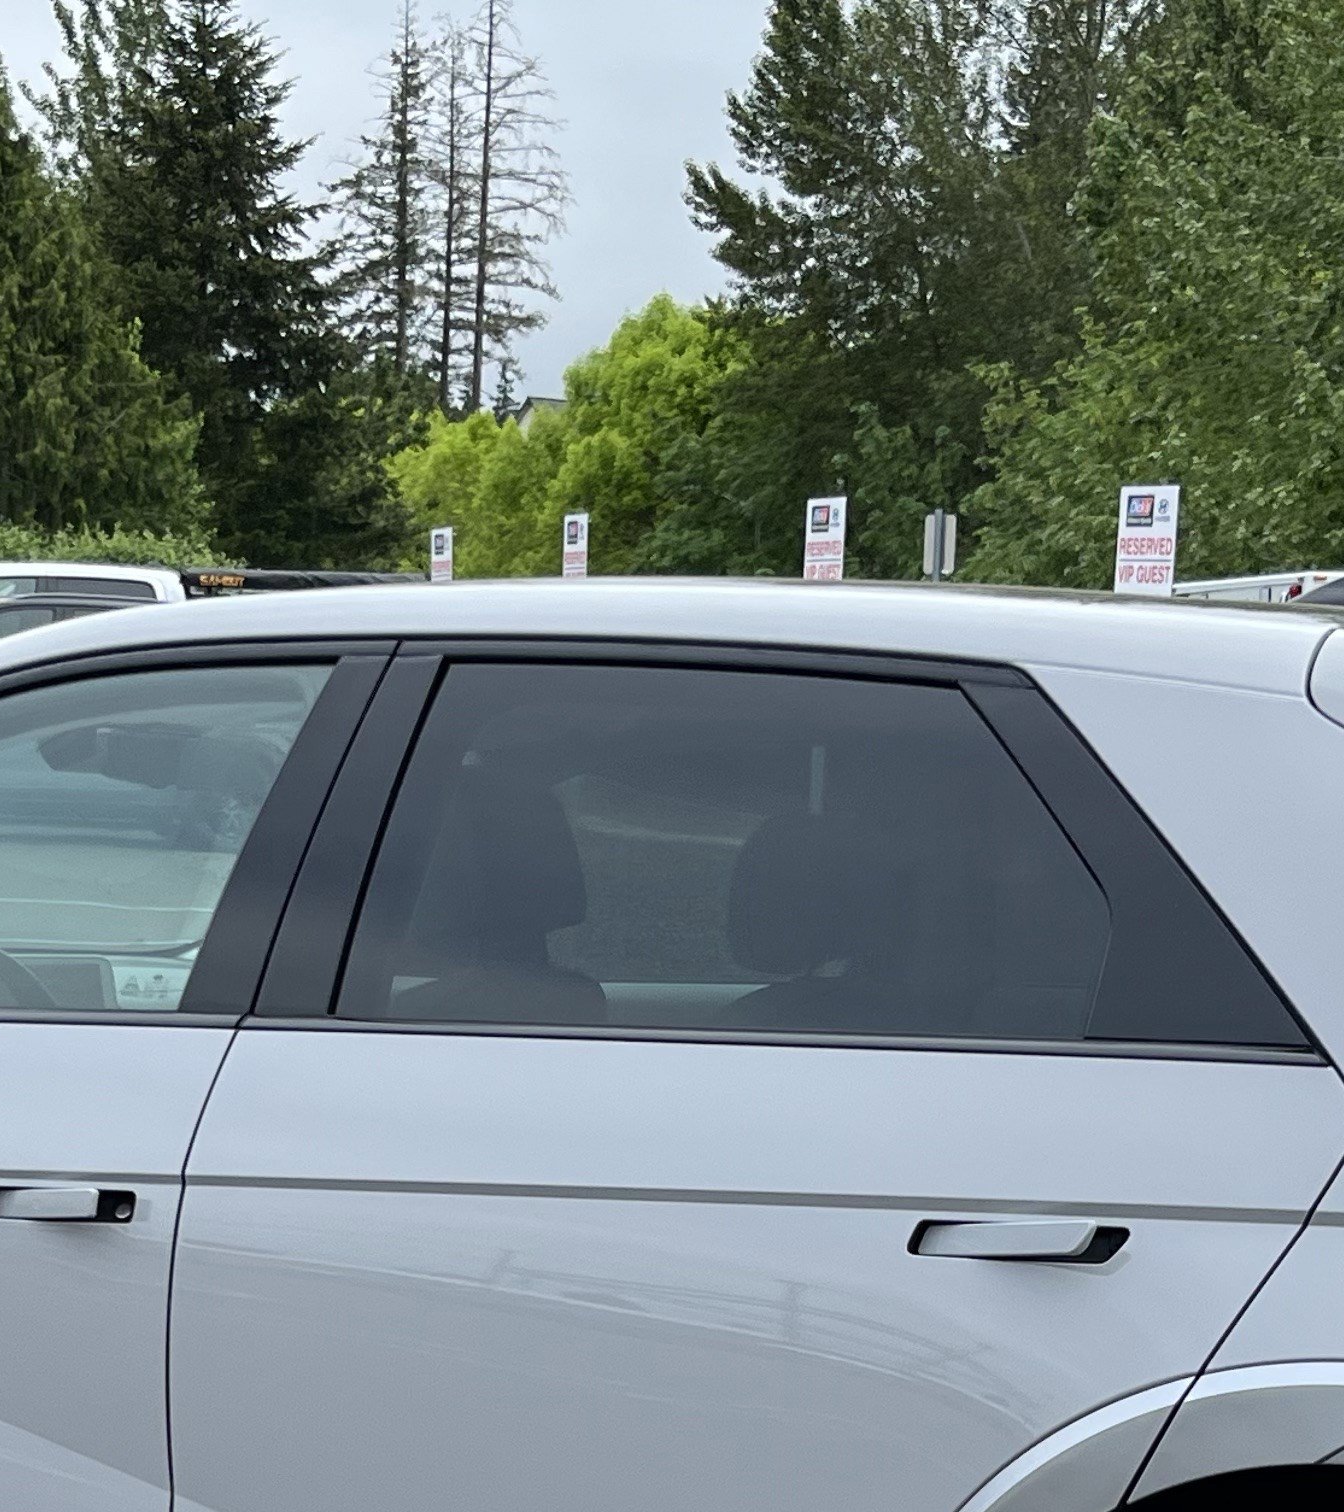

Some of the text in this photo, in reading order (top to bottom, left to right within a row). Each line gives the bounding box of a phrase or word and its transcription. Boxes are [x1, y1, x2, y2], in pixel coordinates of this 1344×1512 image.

[1119, 537, 1173, 556] RESERVED
[1118, 565, 1171, 584] VIP GUEST
